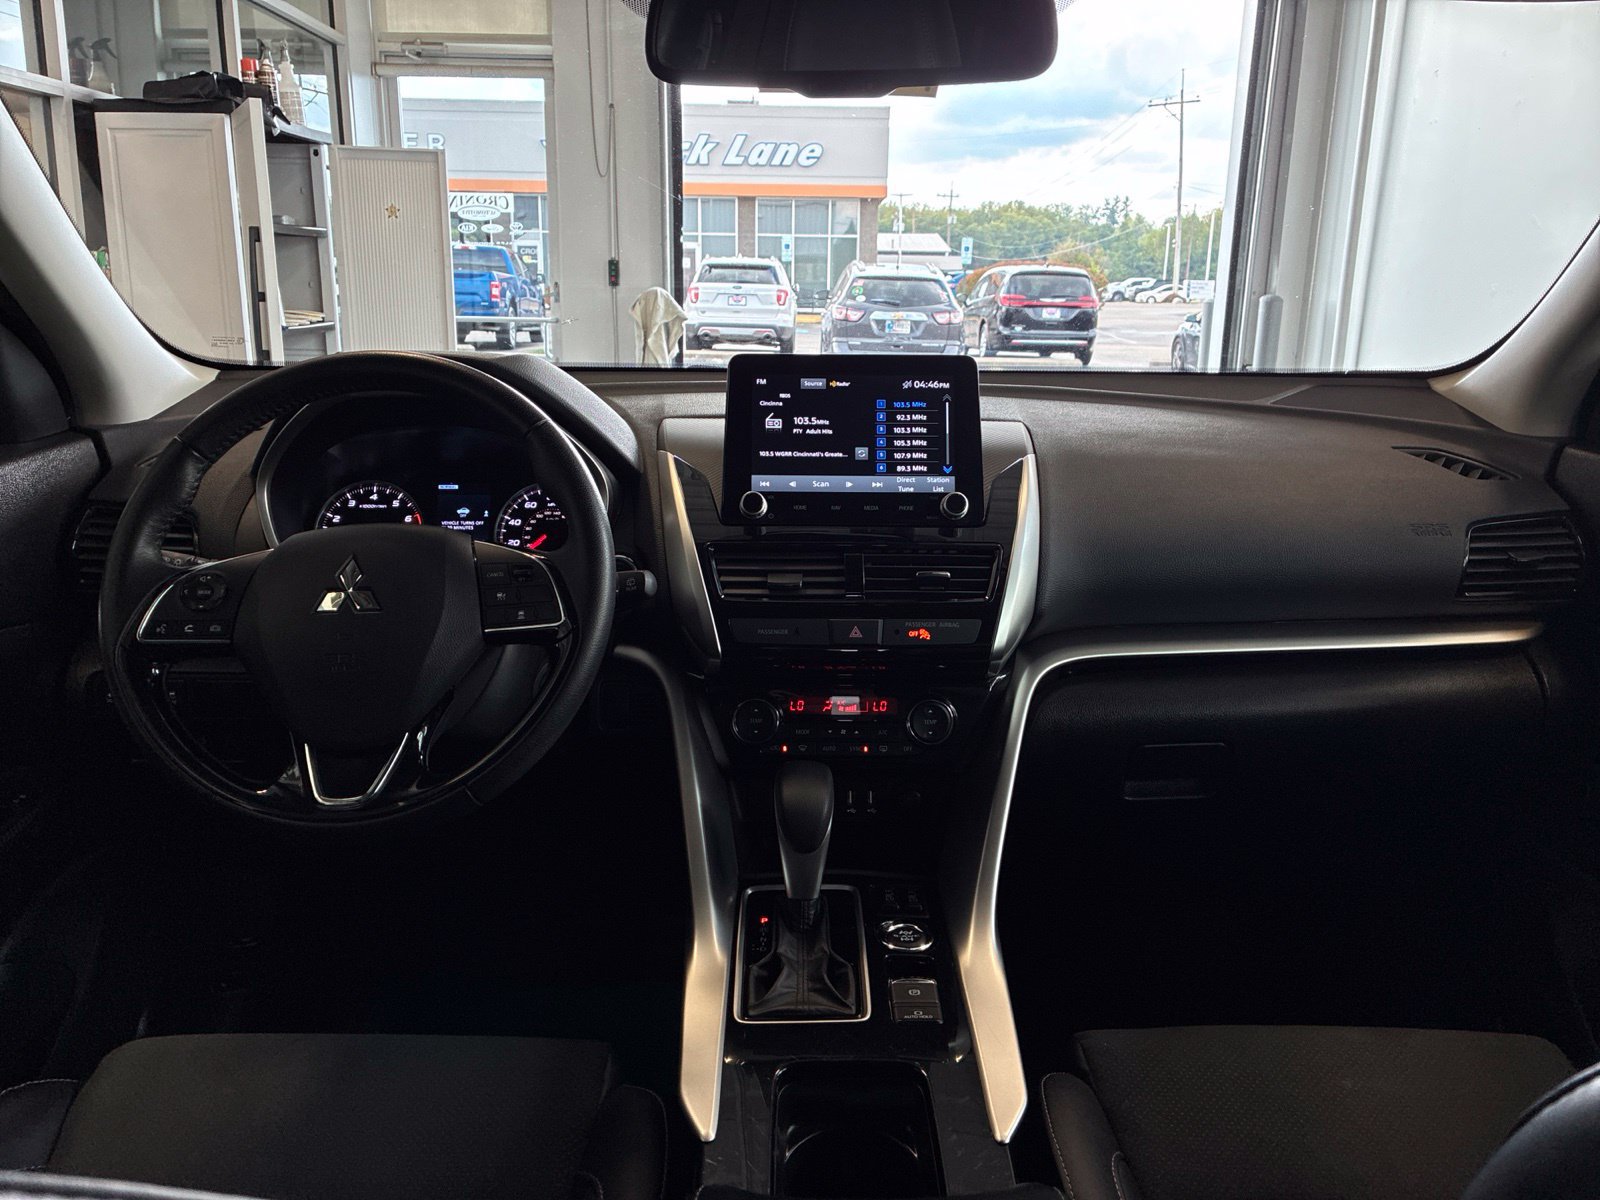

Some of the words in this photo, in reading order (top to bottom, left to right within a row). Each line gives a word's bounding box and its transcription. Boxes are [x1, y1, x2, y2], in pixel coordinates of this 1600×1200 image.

[722, 134, 824, 168] Lane
[520, 247, 537, 255] CRO
[893, 439, 911, 447] 105.3
[812, 480, 830, 488] Scan
[898, 485, 914, 493] Tune
[932, 485, 944, 493] List
[369, 493, 379, 501] 4
[347, 499, 356, 507] 3
[391, 499, 400, 507] 5
[524, 501, 538, 509] 60
[332, 514, 341, 523] 2
[404, 514, 413, 523] 6
[507, 539, 520, 547] 20
[908, 630, 919, 638] OFF
[789, 700, 805, 712] LO
[872, 700, 888, 712] LO
